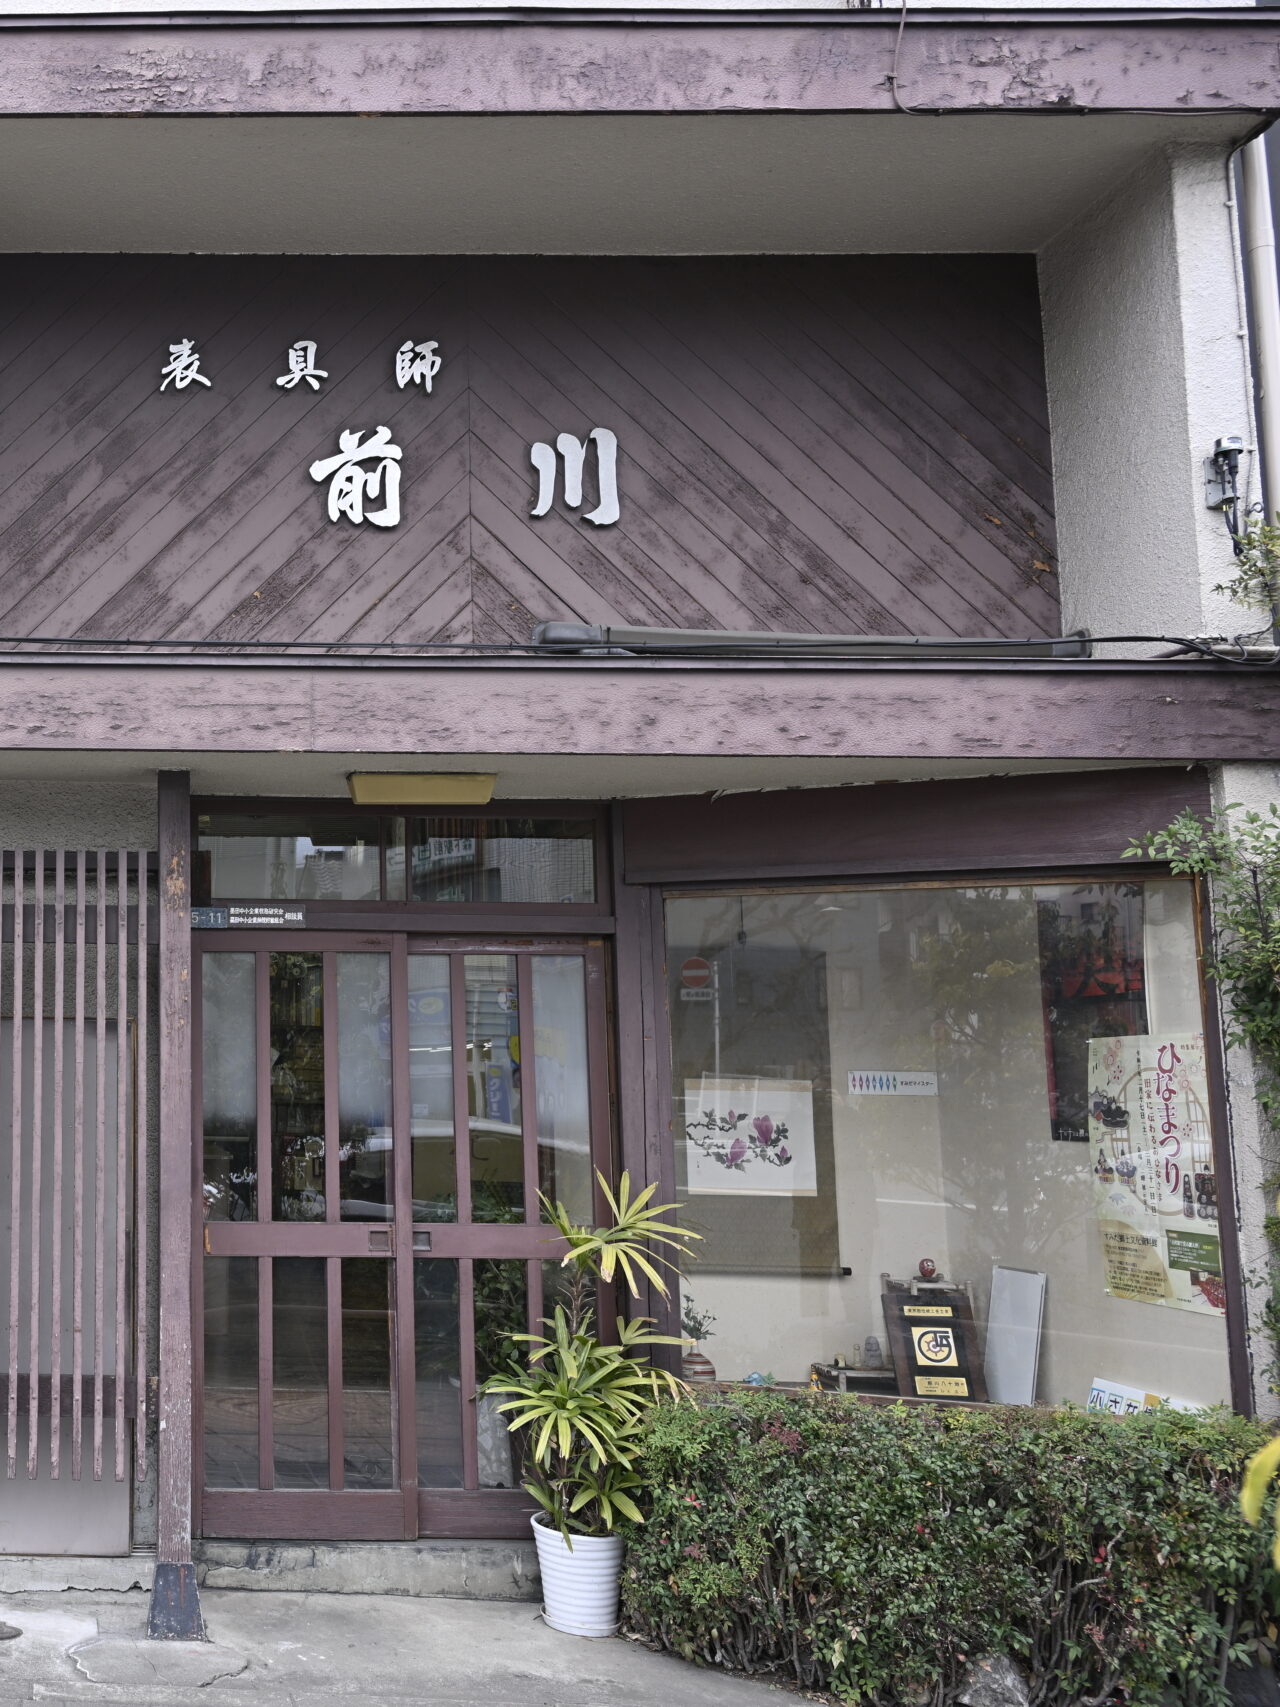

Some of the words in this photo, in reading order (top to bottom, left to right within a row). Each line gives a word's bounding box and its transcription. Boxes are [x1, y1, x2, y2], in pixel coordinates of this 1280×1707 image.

[160, 338, 442, 394] 表具師
[309, 425, 621, 528] 前川
[1152, 1042, 1183, 1194] ひなまつり
